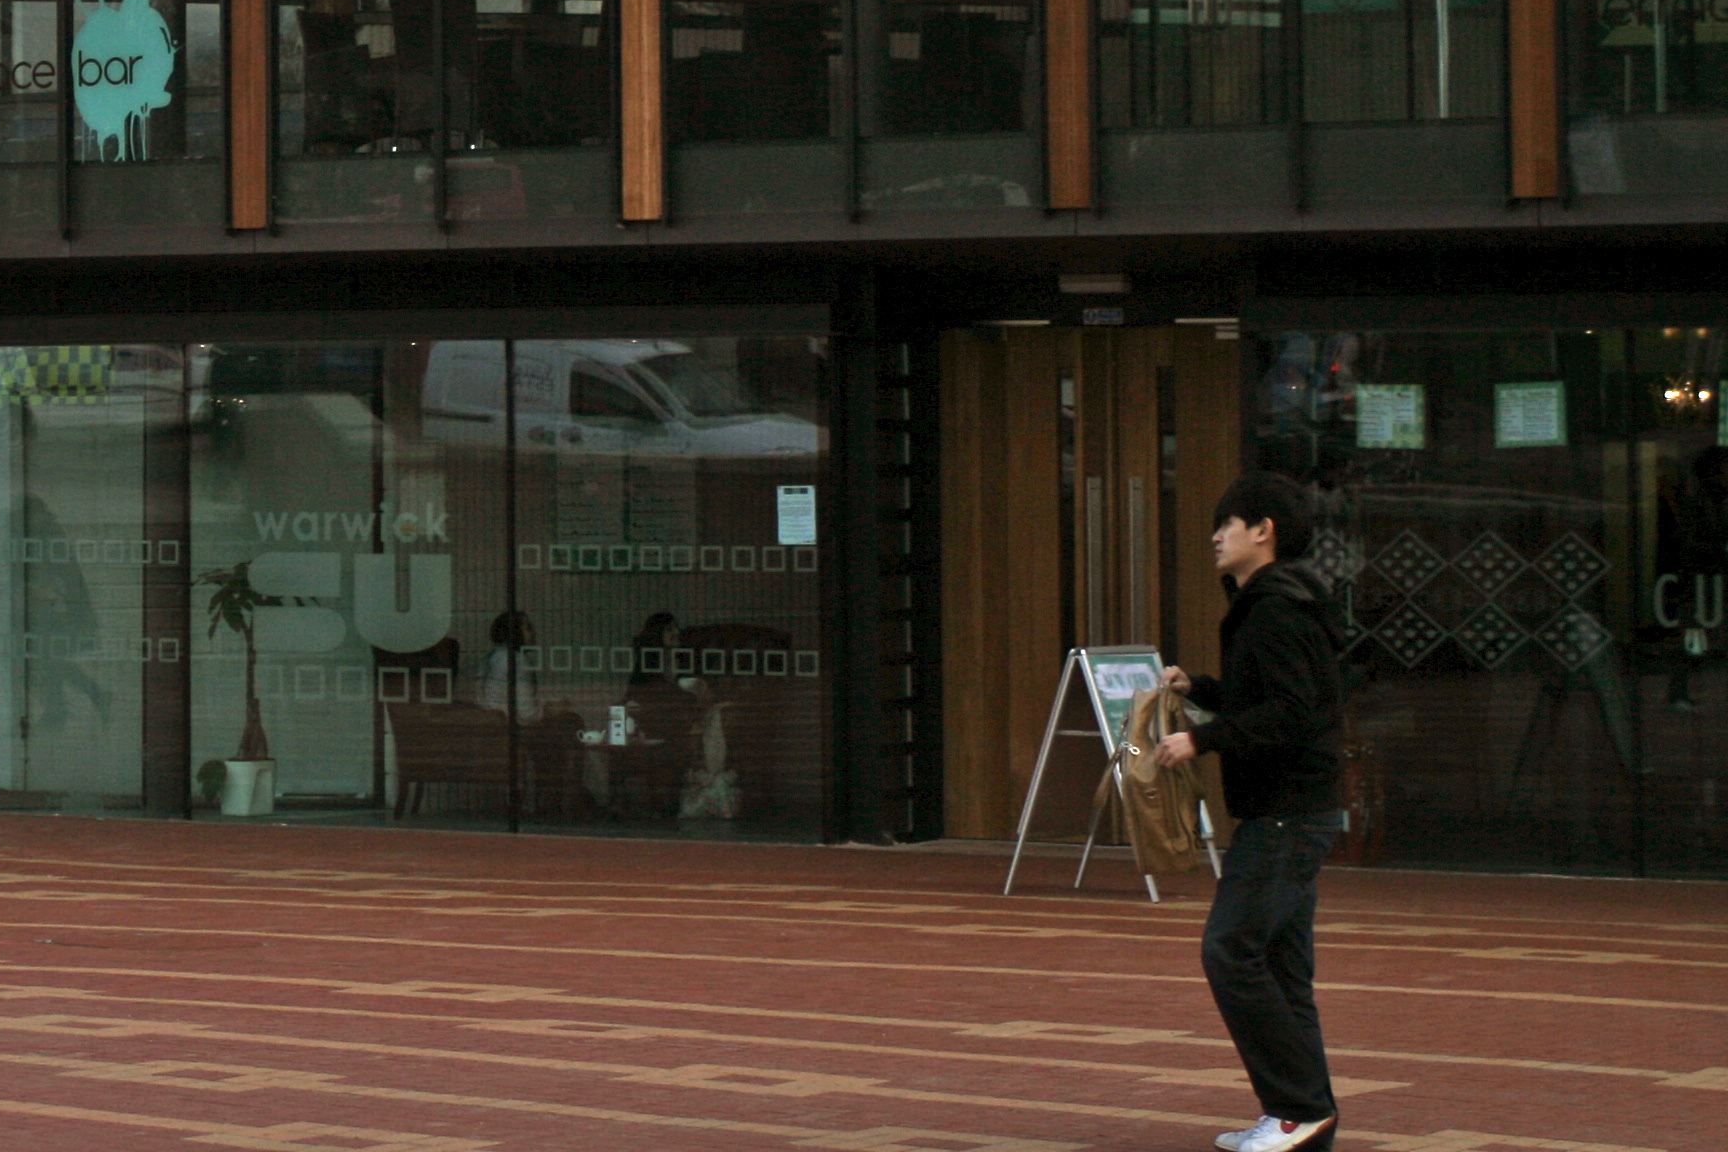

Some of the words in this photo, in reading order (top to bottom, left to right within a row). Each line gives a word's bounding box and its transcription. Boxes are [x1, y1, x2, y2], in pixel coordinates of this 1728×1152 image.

[79, 51, 144, 86] bar
[254, 502, 450, 544] warwick
[247, 552, 452, 653] SU
